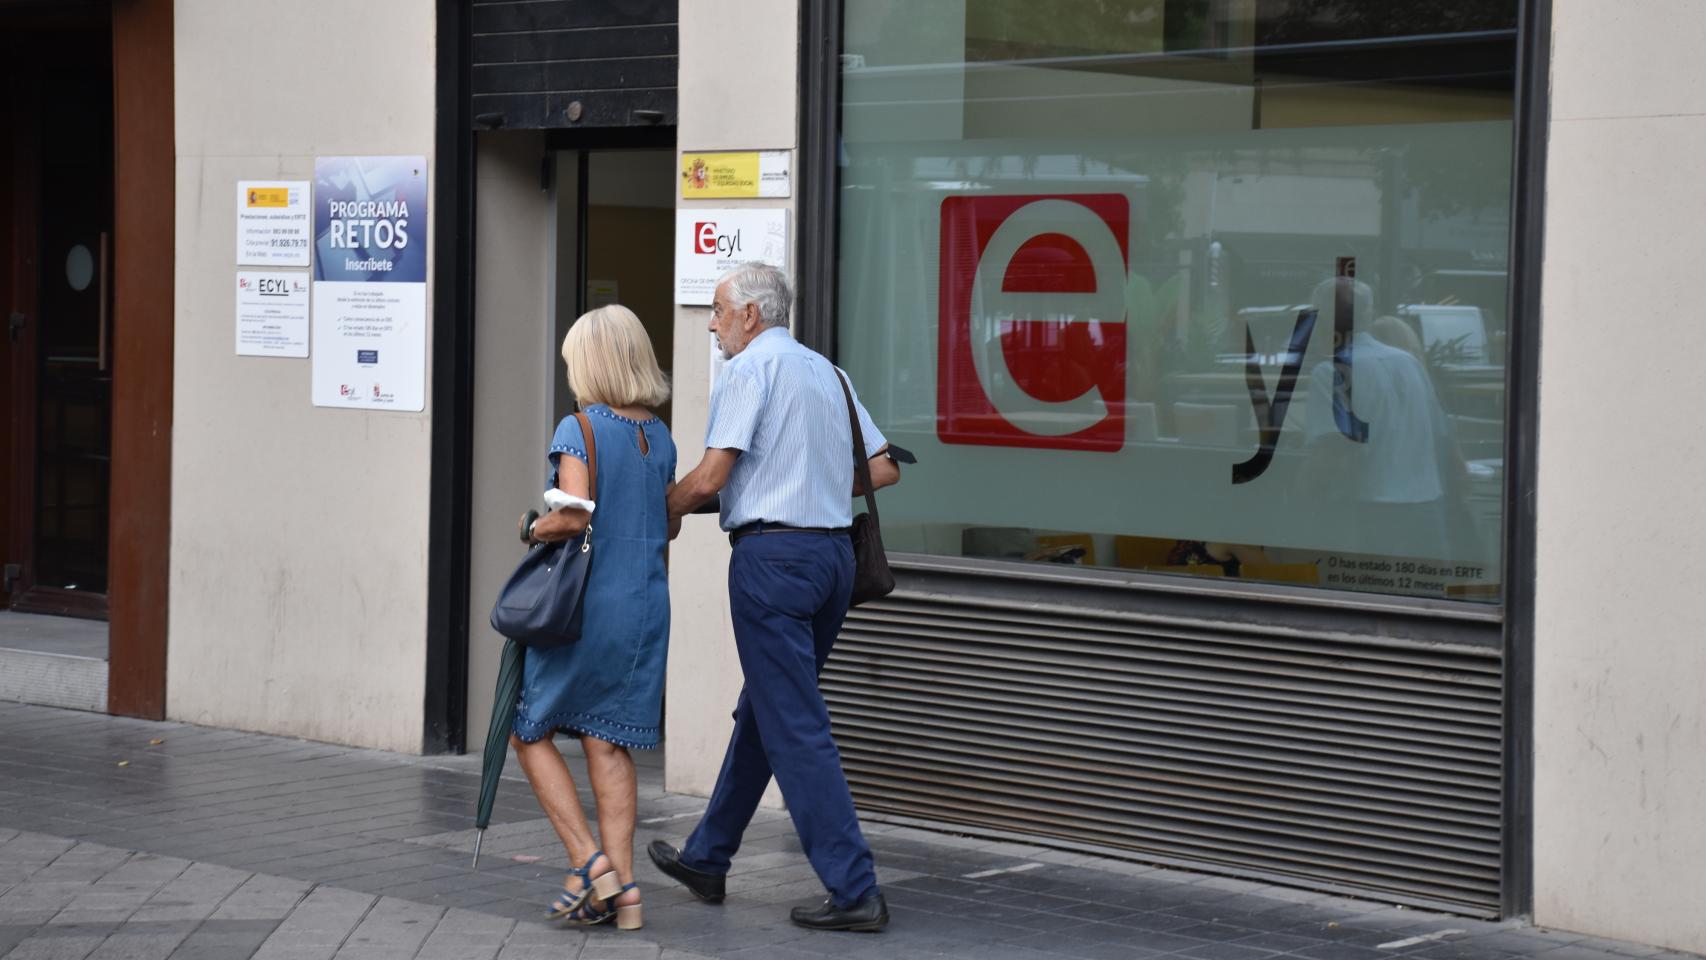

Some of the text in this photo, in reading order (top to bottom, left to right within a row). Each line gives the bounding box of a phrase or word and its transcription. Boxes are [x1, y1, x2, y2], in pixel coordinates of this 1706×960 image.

[330, 201, 409, 218] PROGRAMA
[330, 219, 408, 249] RETOS
[696, 222, 742, 257] ecyl
[345, 257, 393, 271] Inscríbete
[259, 278, 290, 293] ECYL
[1328, 556, 1337, 567] O
[1339, 558, 1356, 569] has
[1358, 561, 1391, 572] estado
[1395, 562, 1415, 574] 180
[1440, 567, 1453, 577] en
[1455, 566, 1485, 579] ERTE
[1328, 574, 1340, 582] en
[1342, 572, 1357, 584] los
[1358, 574, 1394, 588] últimos
[1399, 577, 1411, 588] 12
